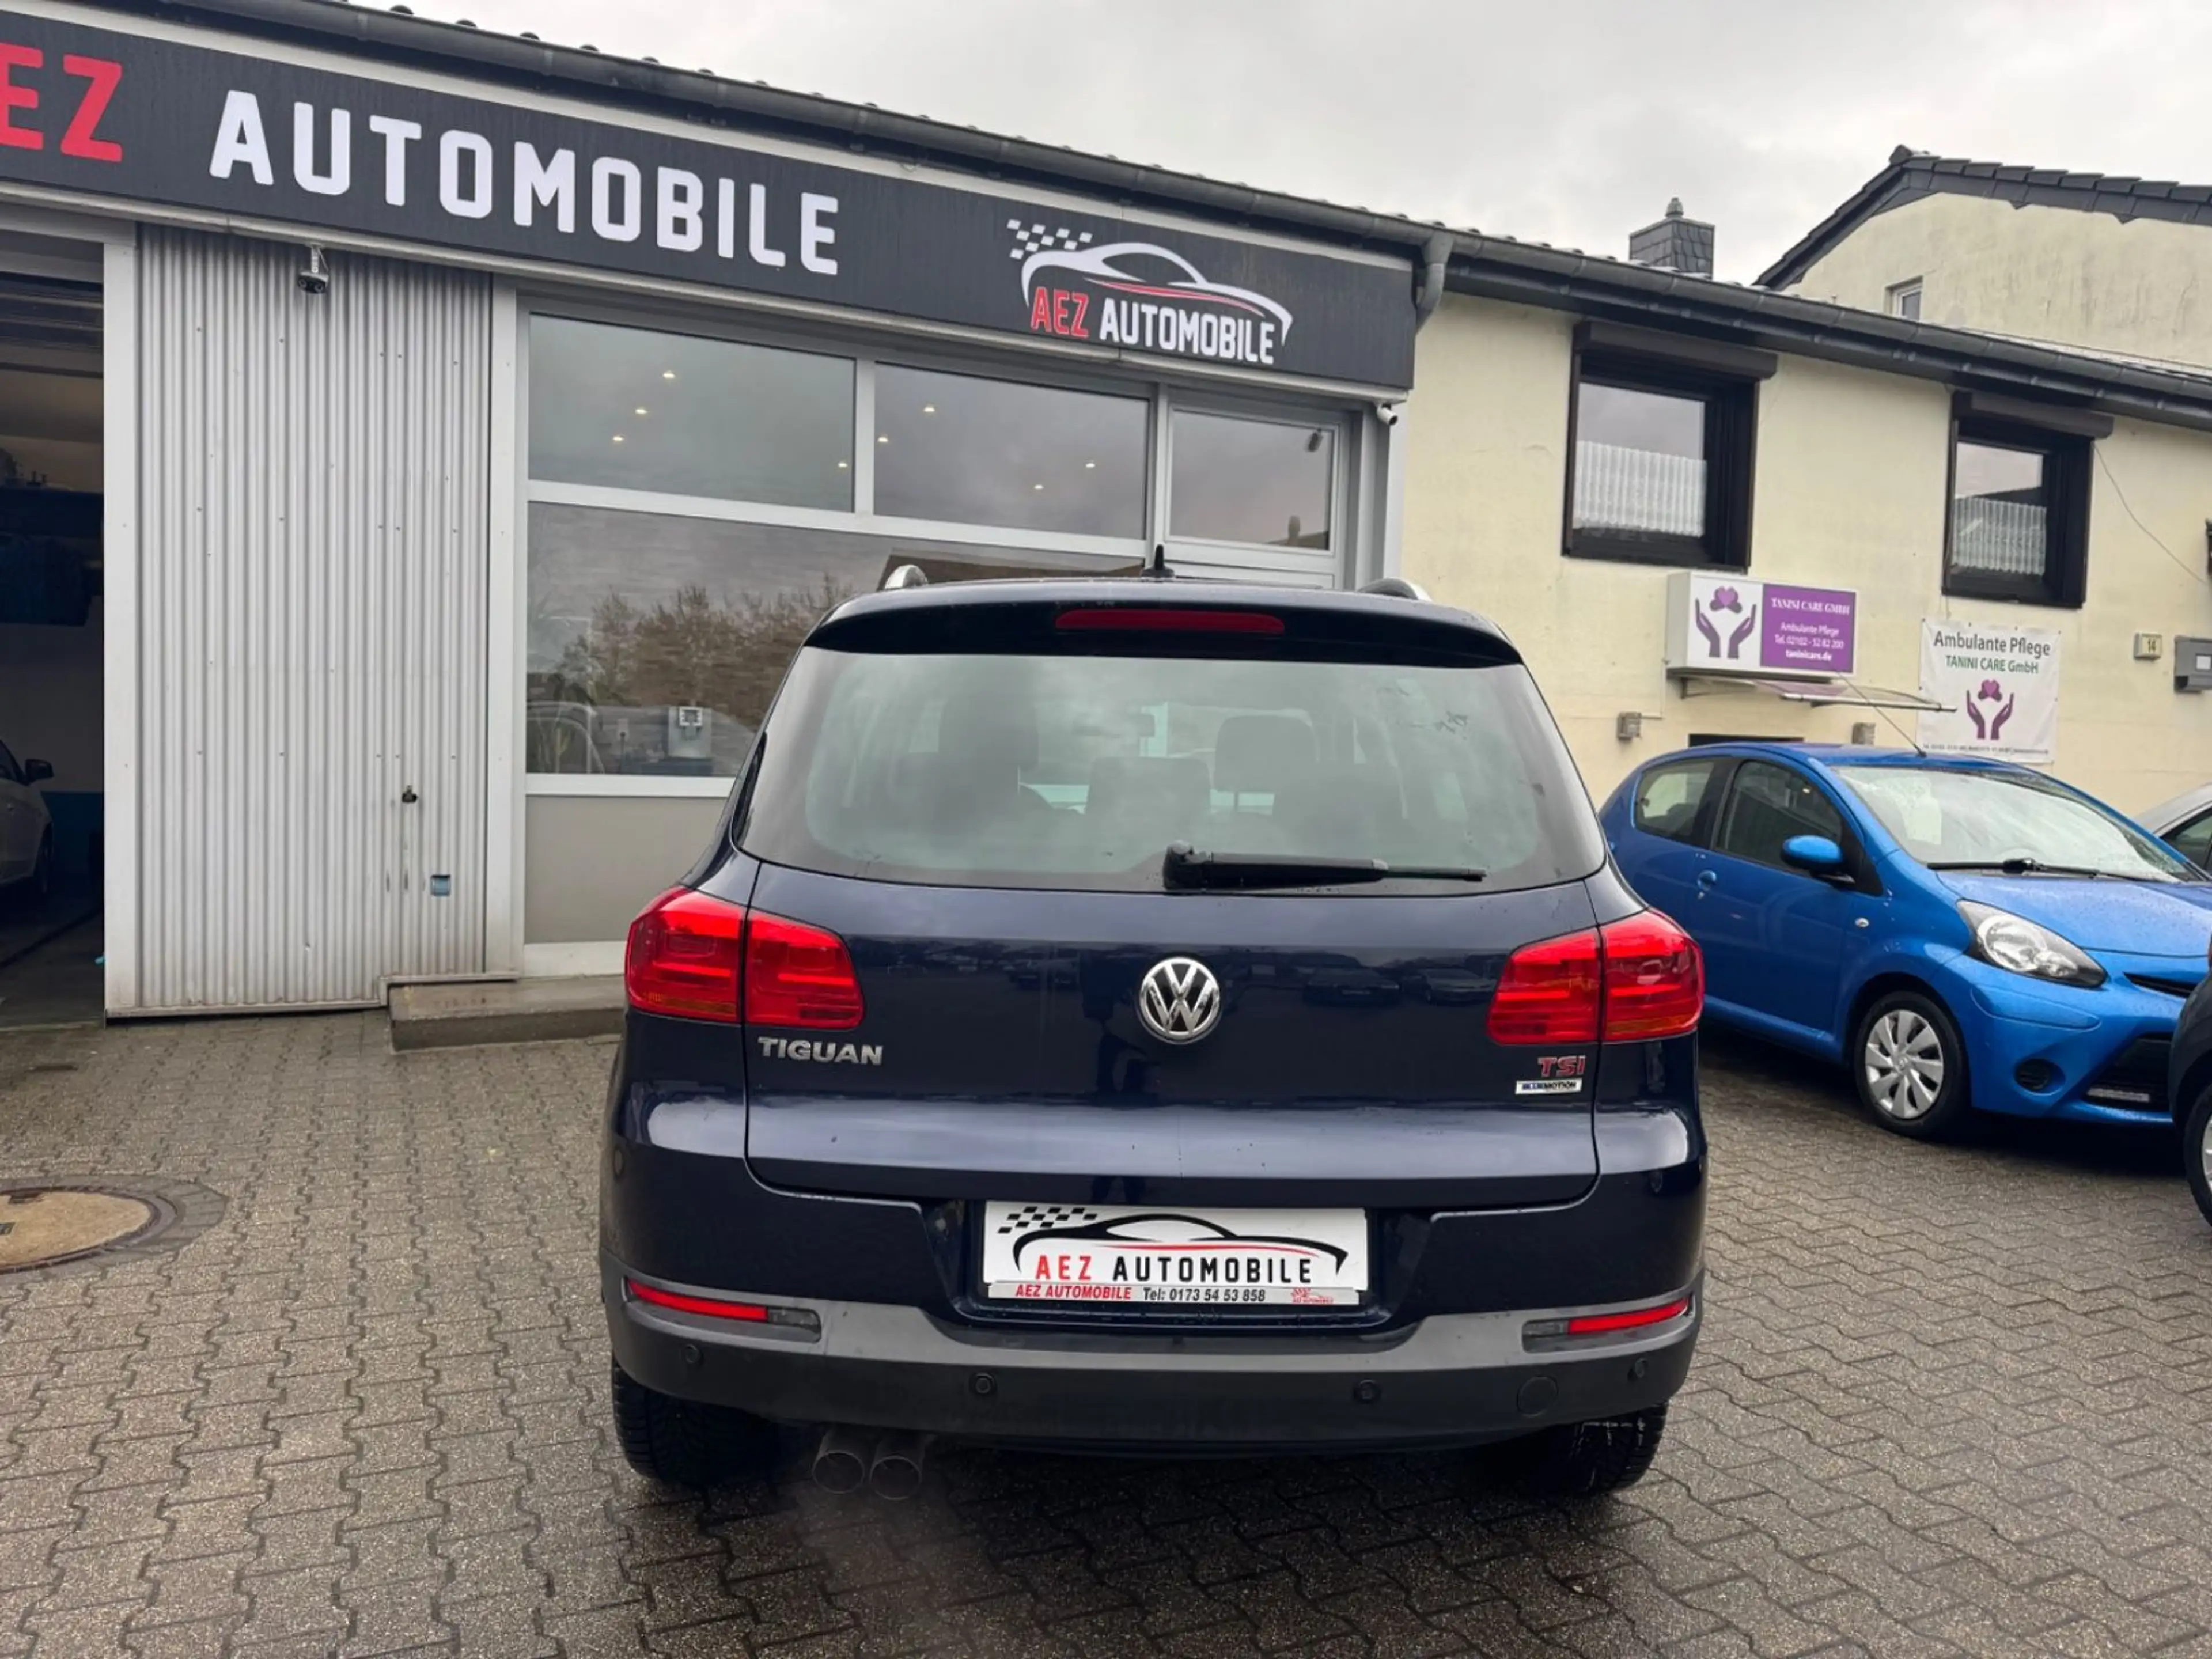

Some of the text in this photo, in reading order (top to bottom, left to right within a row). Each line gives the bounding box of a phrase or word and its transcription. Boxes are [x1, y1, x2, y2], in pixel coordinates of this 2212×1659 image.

[209, 90, 838, 275] AUTOMOBILE
[1030, 286, 1275, 365] AEZ AUTOMOBILE
[1934, 631, 2051, 660] Ambulante Pflege
[1945, 655, 2039, 674] TANINI CARE GmbH
[758, 1036, 884, 1066] TIGUAN
[1537, 1055, 1586, 1077] TSI
[1035, 1254, 1312, 1283] AEZ AUTOMOBILE
[1016, 1283, 1266, 1302] AEZ AUTOMOBILE Tel: 0173 54 53 858
